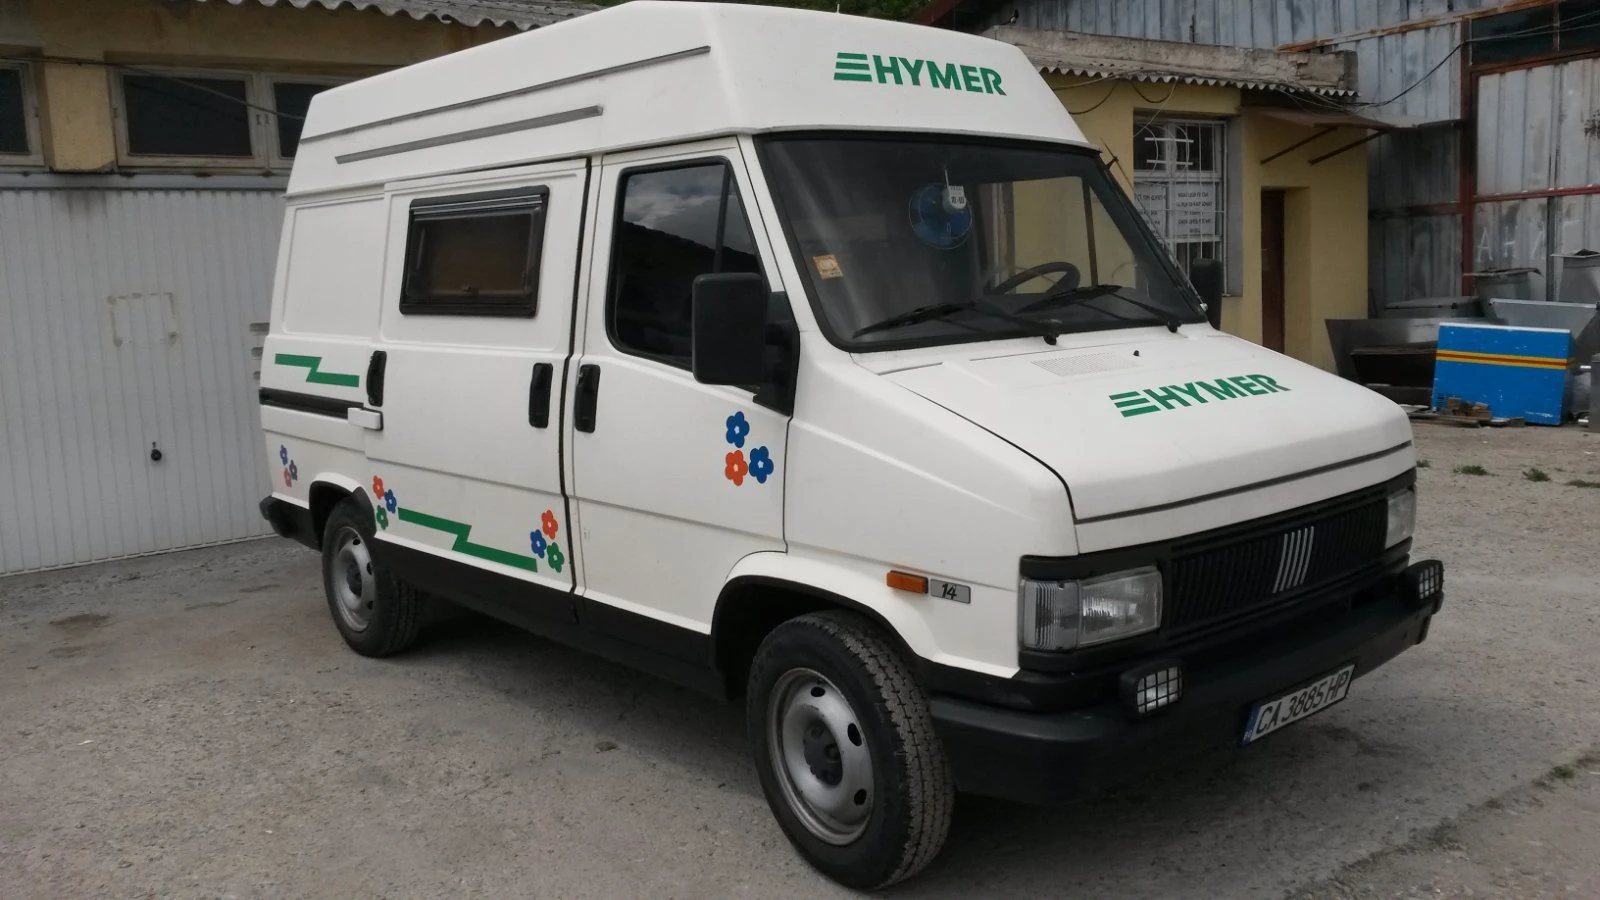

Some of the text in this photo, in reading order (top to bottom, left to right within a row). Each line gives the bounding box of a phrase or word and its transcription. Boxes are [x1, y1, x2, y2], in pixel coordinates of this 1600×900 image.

[941, 583, 957, 600] 14
[1255, 670, 1350, 734] CA 3885 HP
